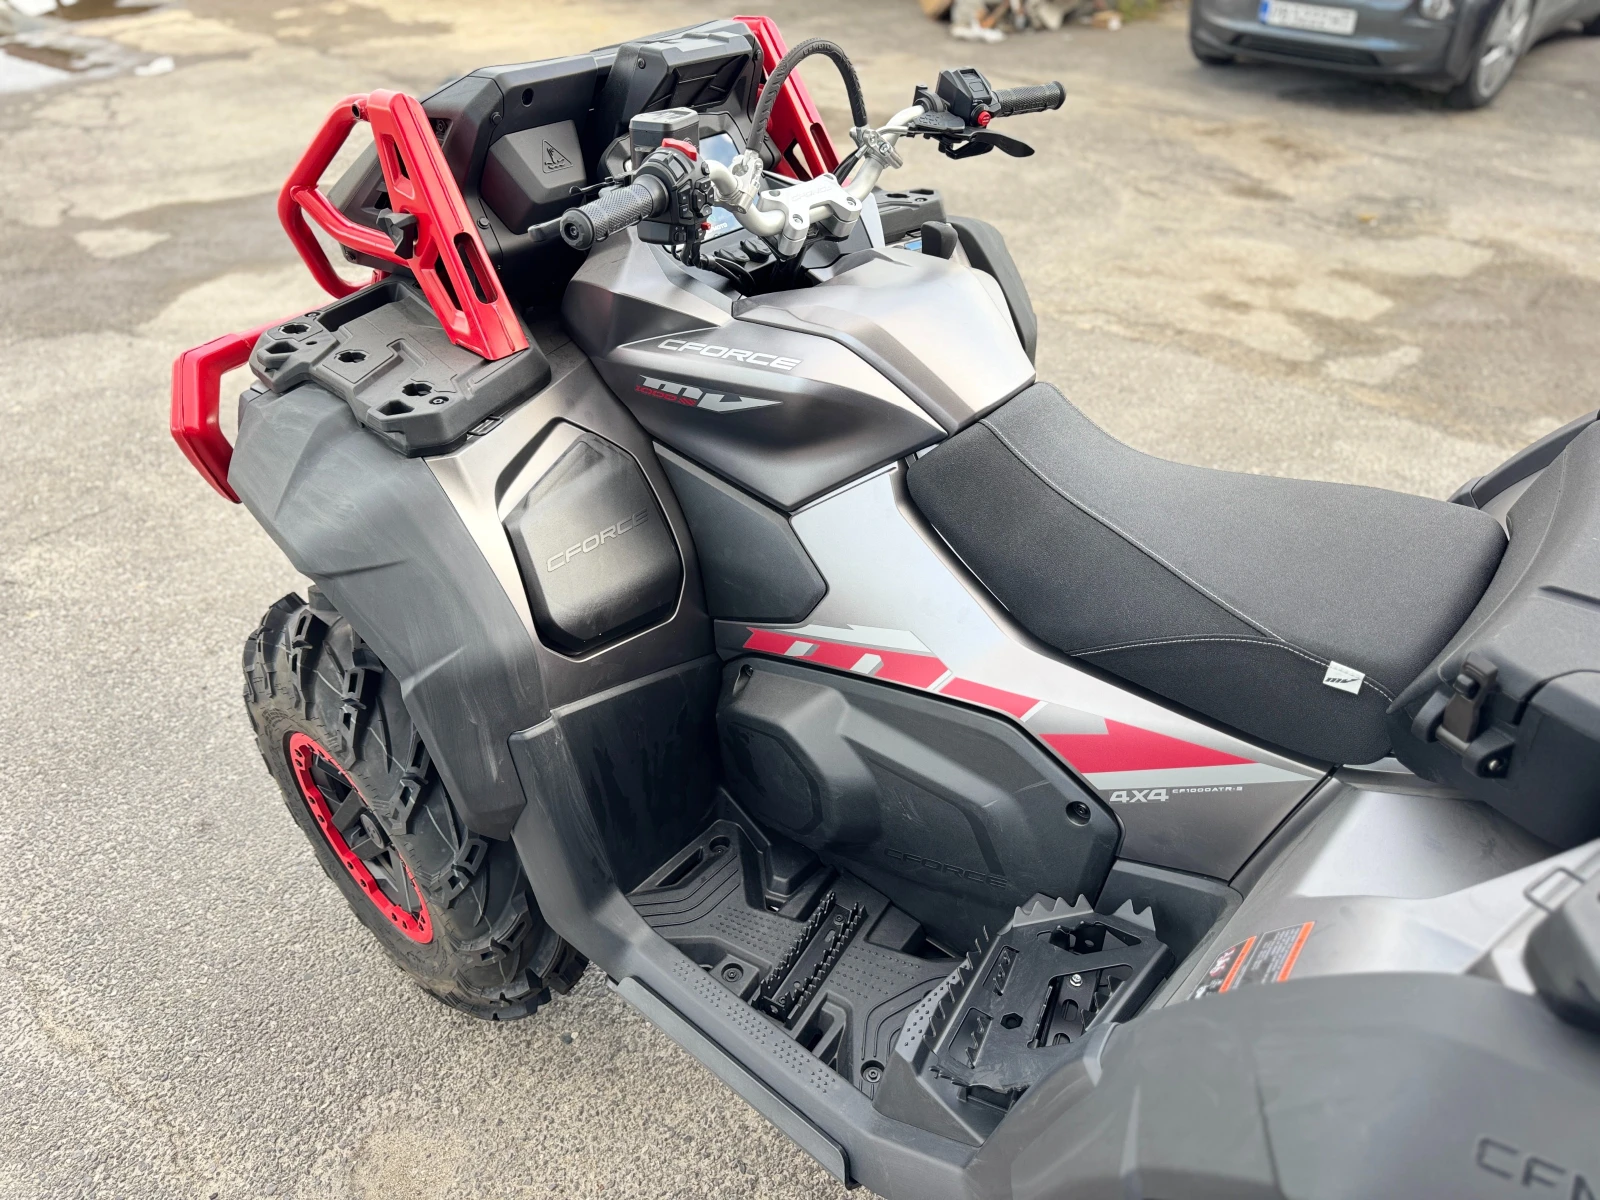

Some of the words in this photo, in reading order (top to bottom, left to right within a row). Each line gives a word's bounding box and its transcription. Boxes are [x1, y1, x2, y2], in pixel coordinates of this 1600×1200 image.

[657, 338, 802, 370] CFORCE
[546, 507, 649, 572] CFORCE
[884, 848, 1008, 888] CFORCE
